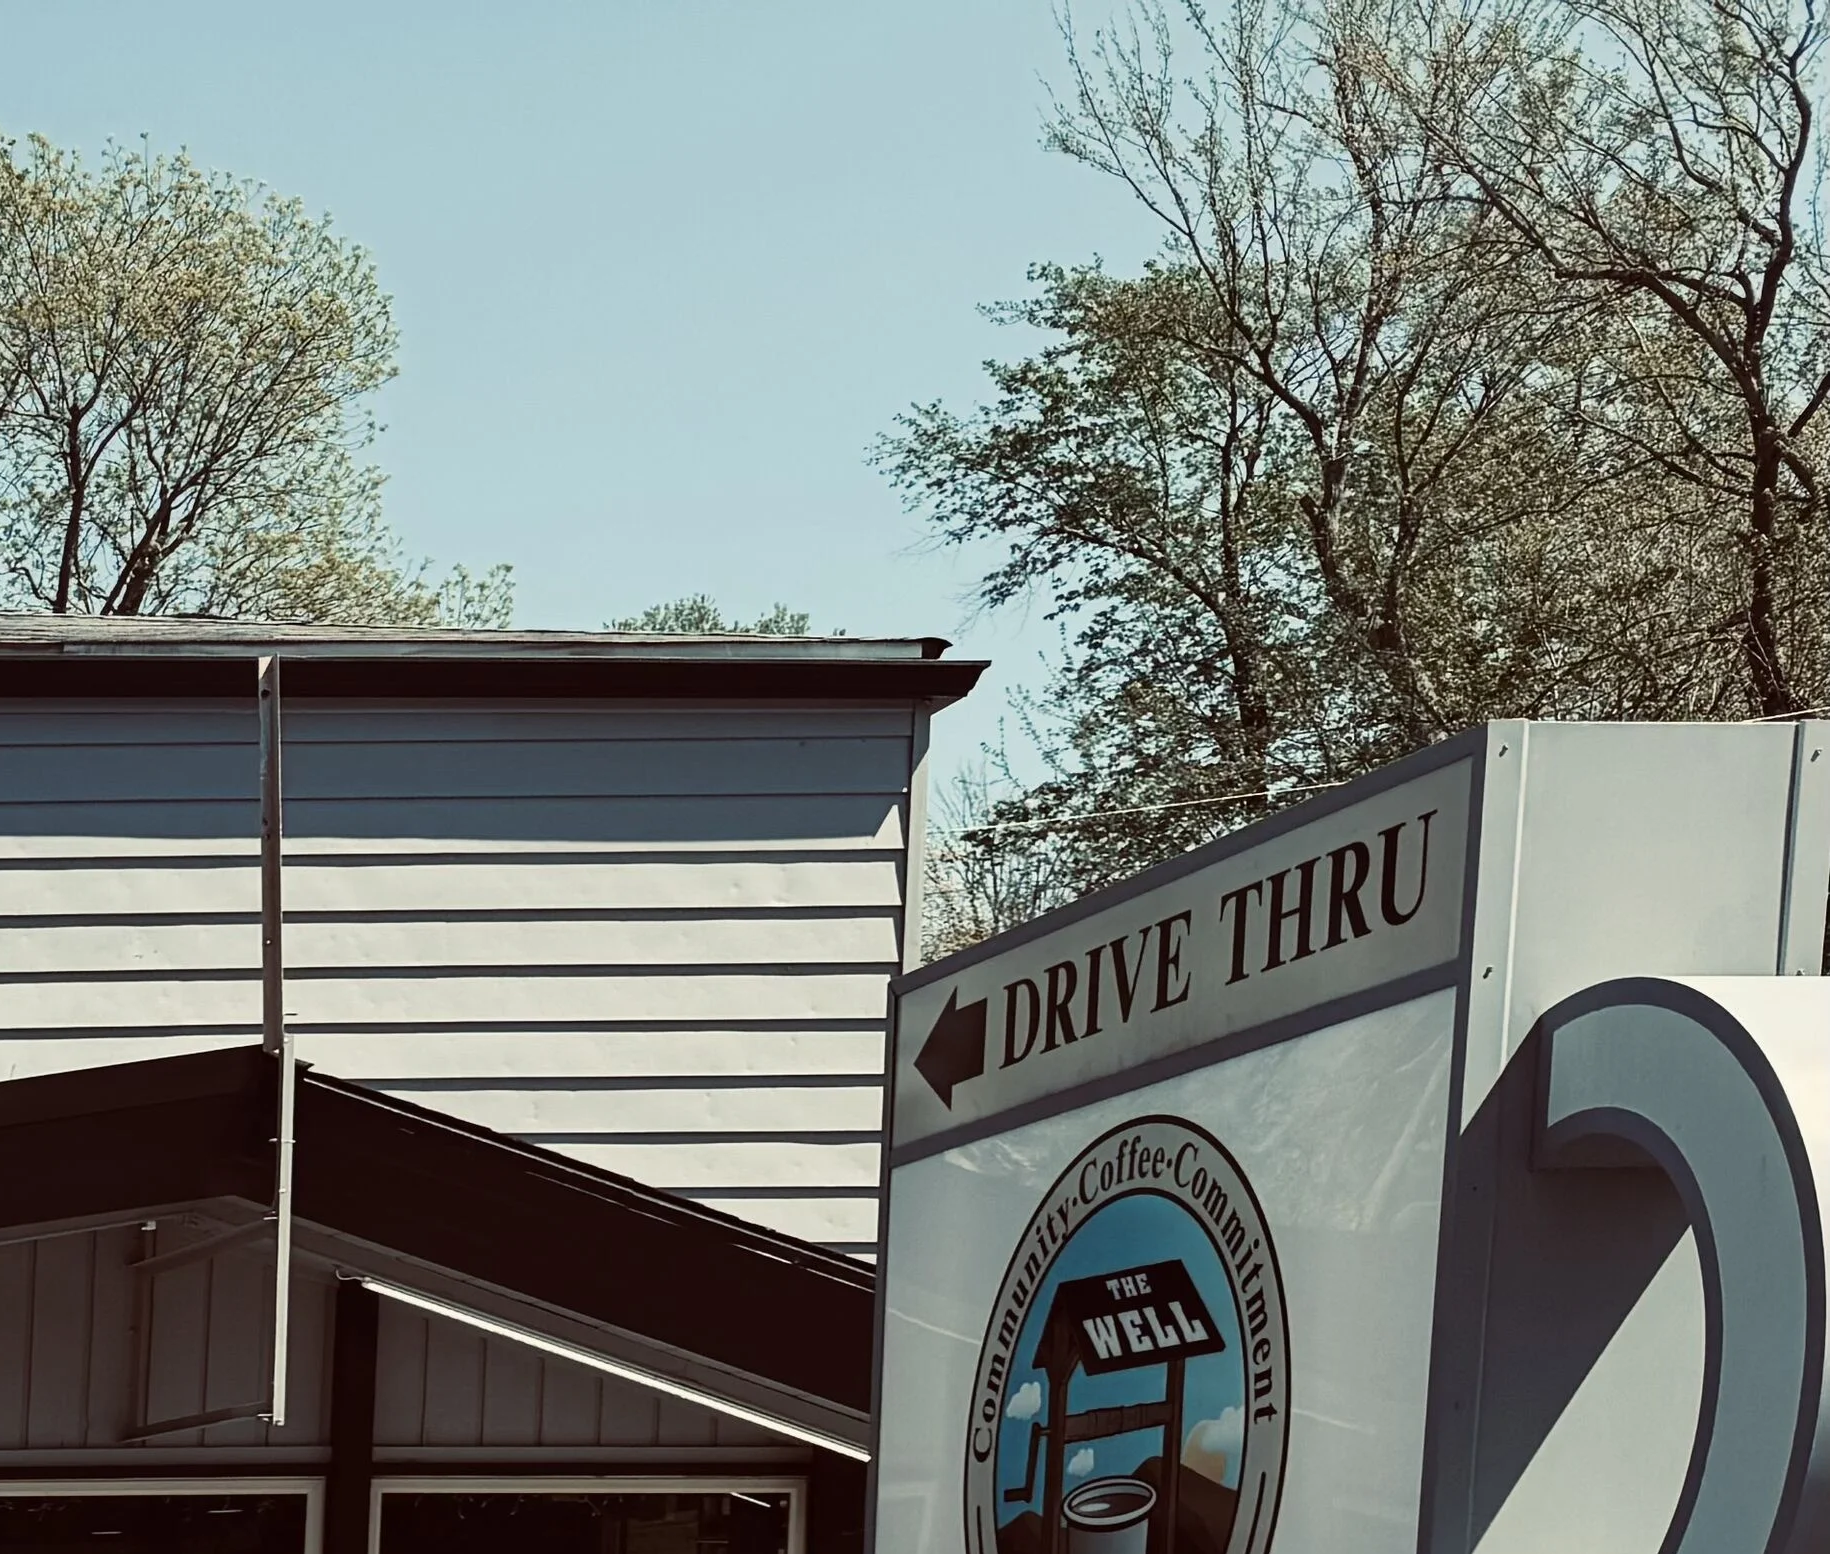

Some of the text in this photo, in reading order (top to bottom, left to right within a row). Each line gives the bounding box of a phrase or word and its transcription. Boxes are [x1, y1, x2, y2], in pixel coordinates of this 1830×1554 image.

[998, 808, 1439, 1070] DRIVE THRU
[1106, 1273, 1152, 1301] THE
[1082, 1301, 1210, 1360] WELL
